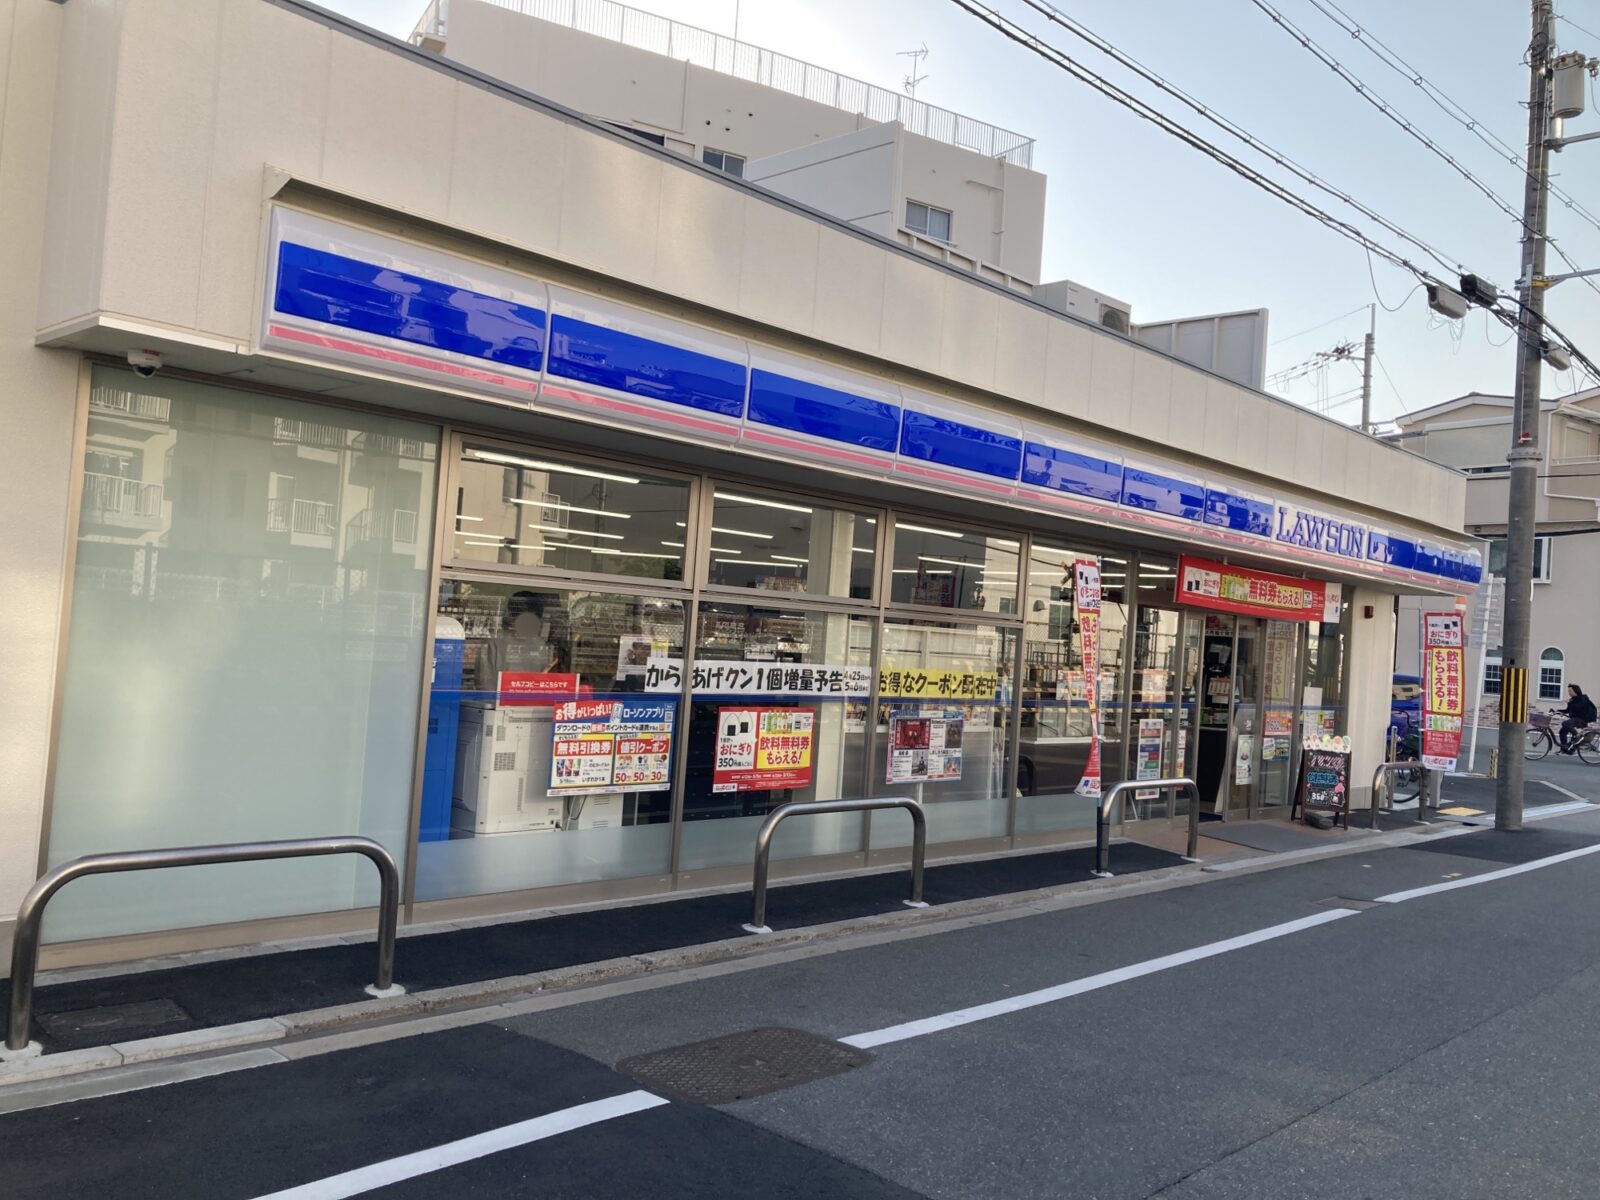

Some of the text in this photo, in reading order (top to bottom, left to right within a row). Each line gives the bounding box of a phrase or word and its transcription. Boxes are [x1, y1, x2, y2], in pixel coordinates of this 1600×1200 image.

[1276, 506, 1366, 558] LAWSON
[1430, 630, 1458, 639] おにぎり
[879, 671, 997, 696] お得なクーポン配布中
[1446, 650, 1459, 711] 飲料無料券
[623, 707, 664, 718] ローソンアプリ
[557, 741, 611, 755] 無料引換券
[620, 740, 667, 753] 値引クーポン
[720, 743, 752, 756] おにぎり
[760, 736, 810, 750] 飲料無料券
[766, 751, 802, 765] もらえる!
